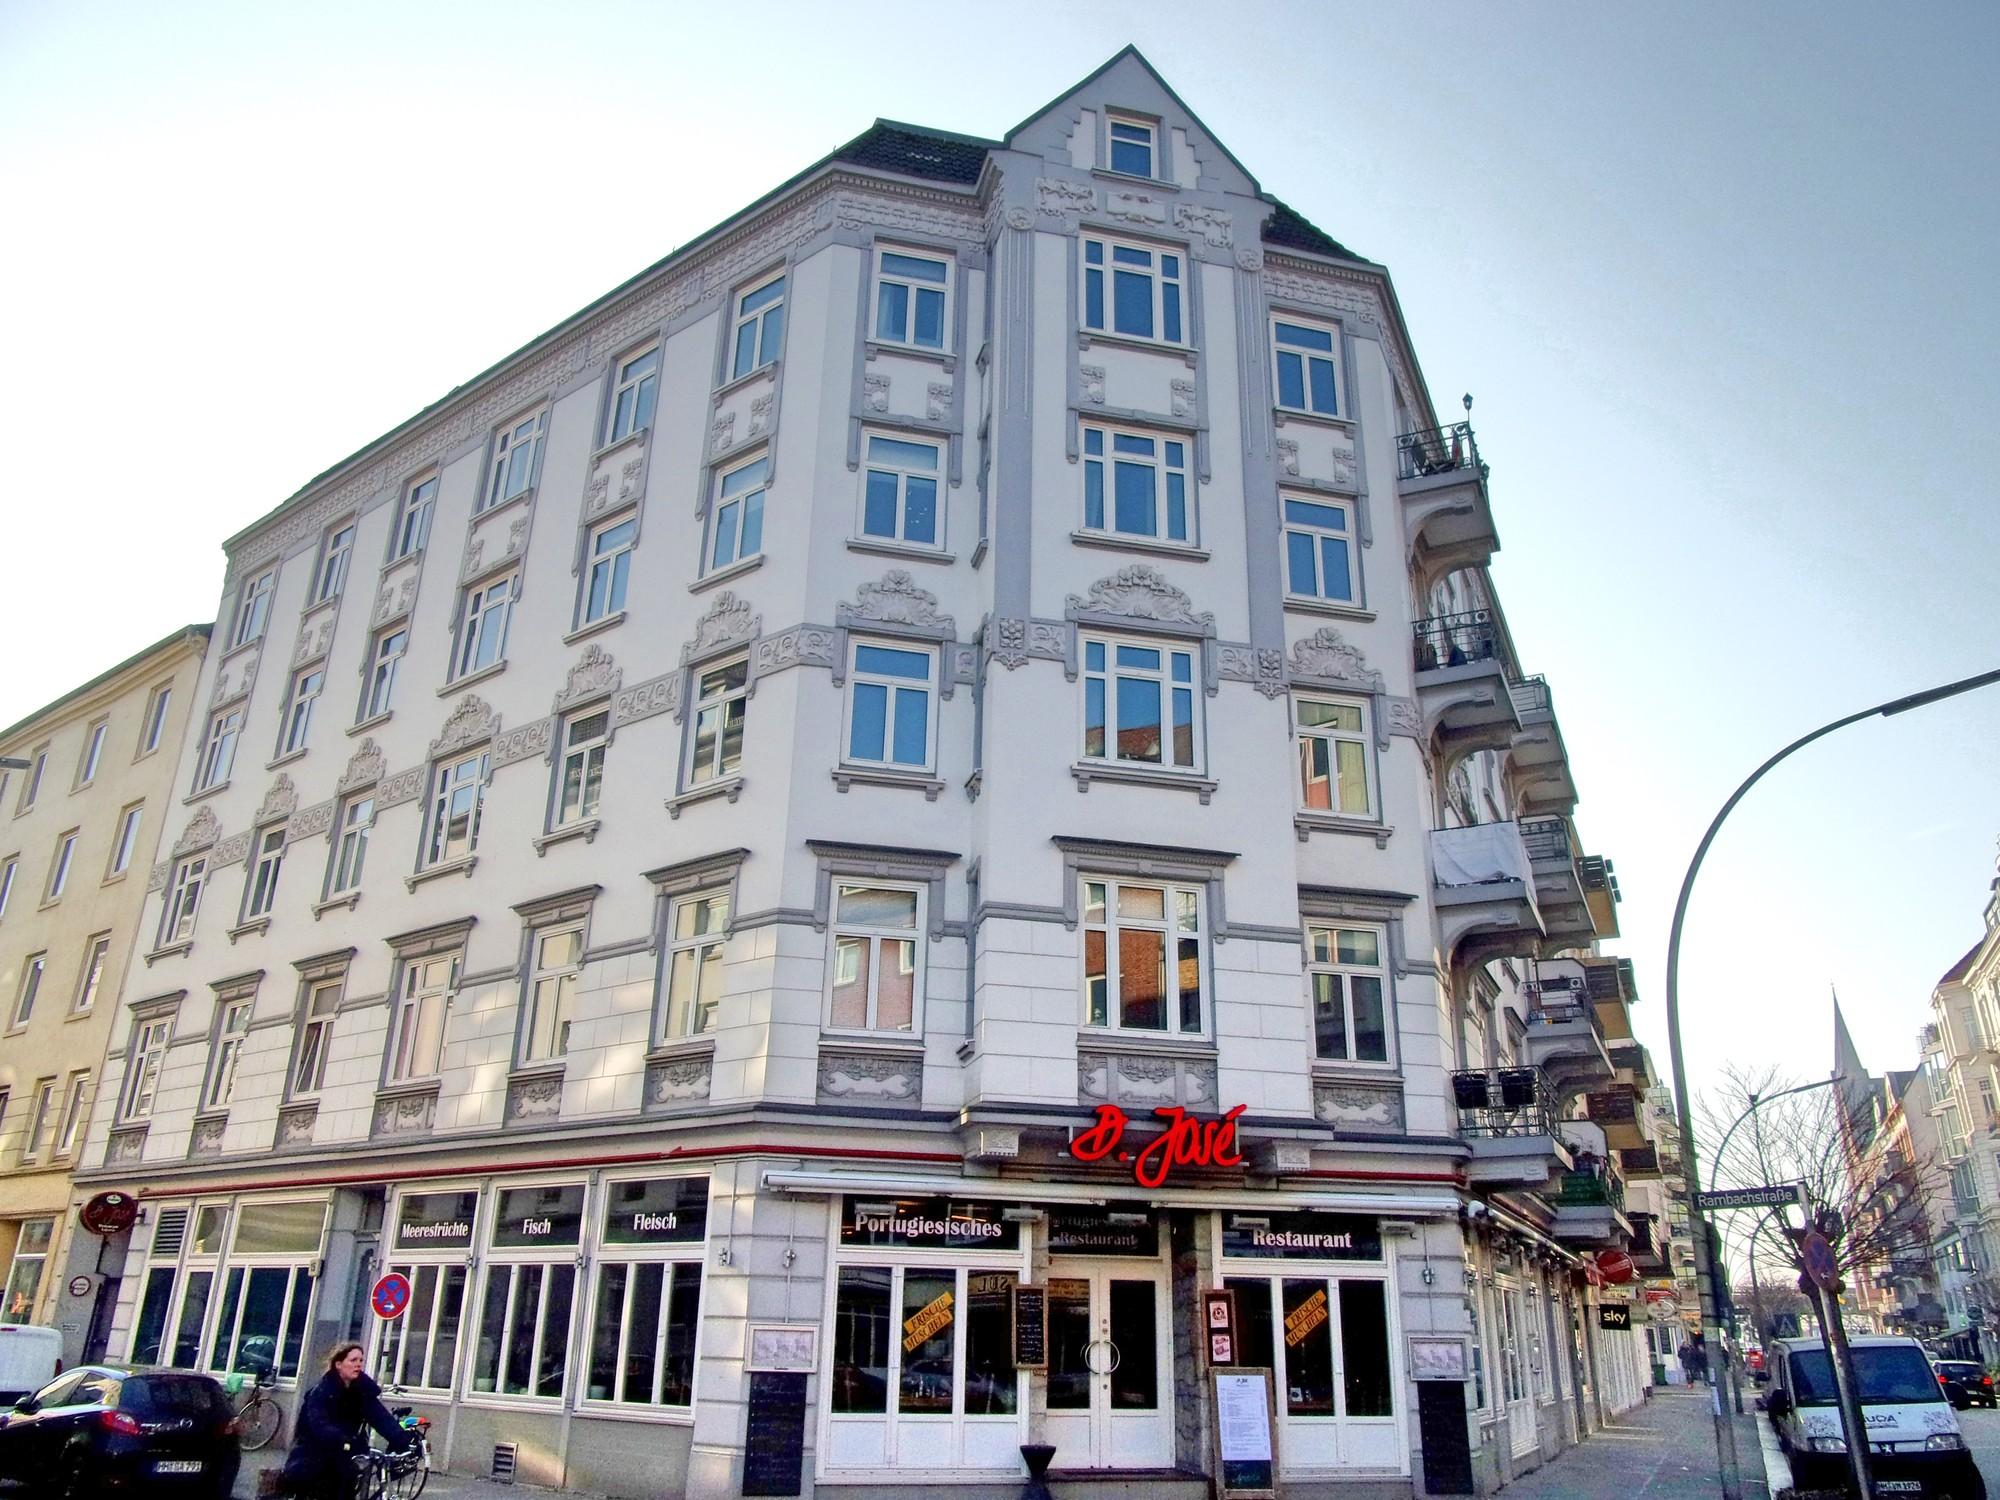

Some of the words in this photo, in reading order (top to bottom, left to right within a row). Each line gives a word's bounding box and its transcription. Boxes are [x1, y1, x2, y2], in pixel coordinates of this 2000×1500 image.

[1071, 1104, 1129, 1162] D.
[1135, 1103, 1248, 1188] José
[1697, 1189, 1793, 1207] Rambachstraße
[401, 1221, 469, 1238] Meeresfrüchte
[522, 1218, 551, 1235] Fisch
[633, 1212, 677, 1231] Fleisch
[855, 1213, 1002, 1238] Portugiesisches
[1252, 1228, 1353, 1248] Restaurant
[910, 1296, 947, 1330] FRISCHE
[1290, 1295, 1320, 1327] FRISCHE
[1603, 1309, 1626, 1324] sky
[905, 1310, 951, 1348] MUSCHELN
[1287, 1308, 1324, 1344] MUSCHELN
